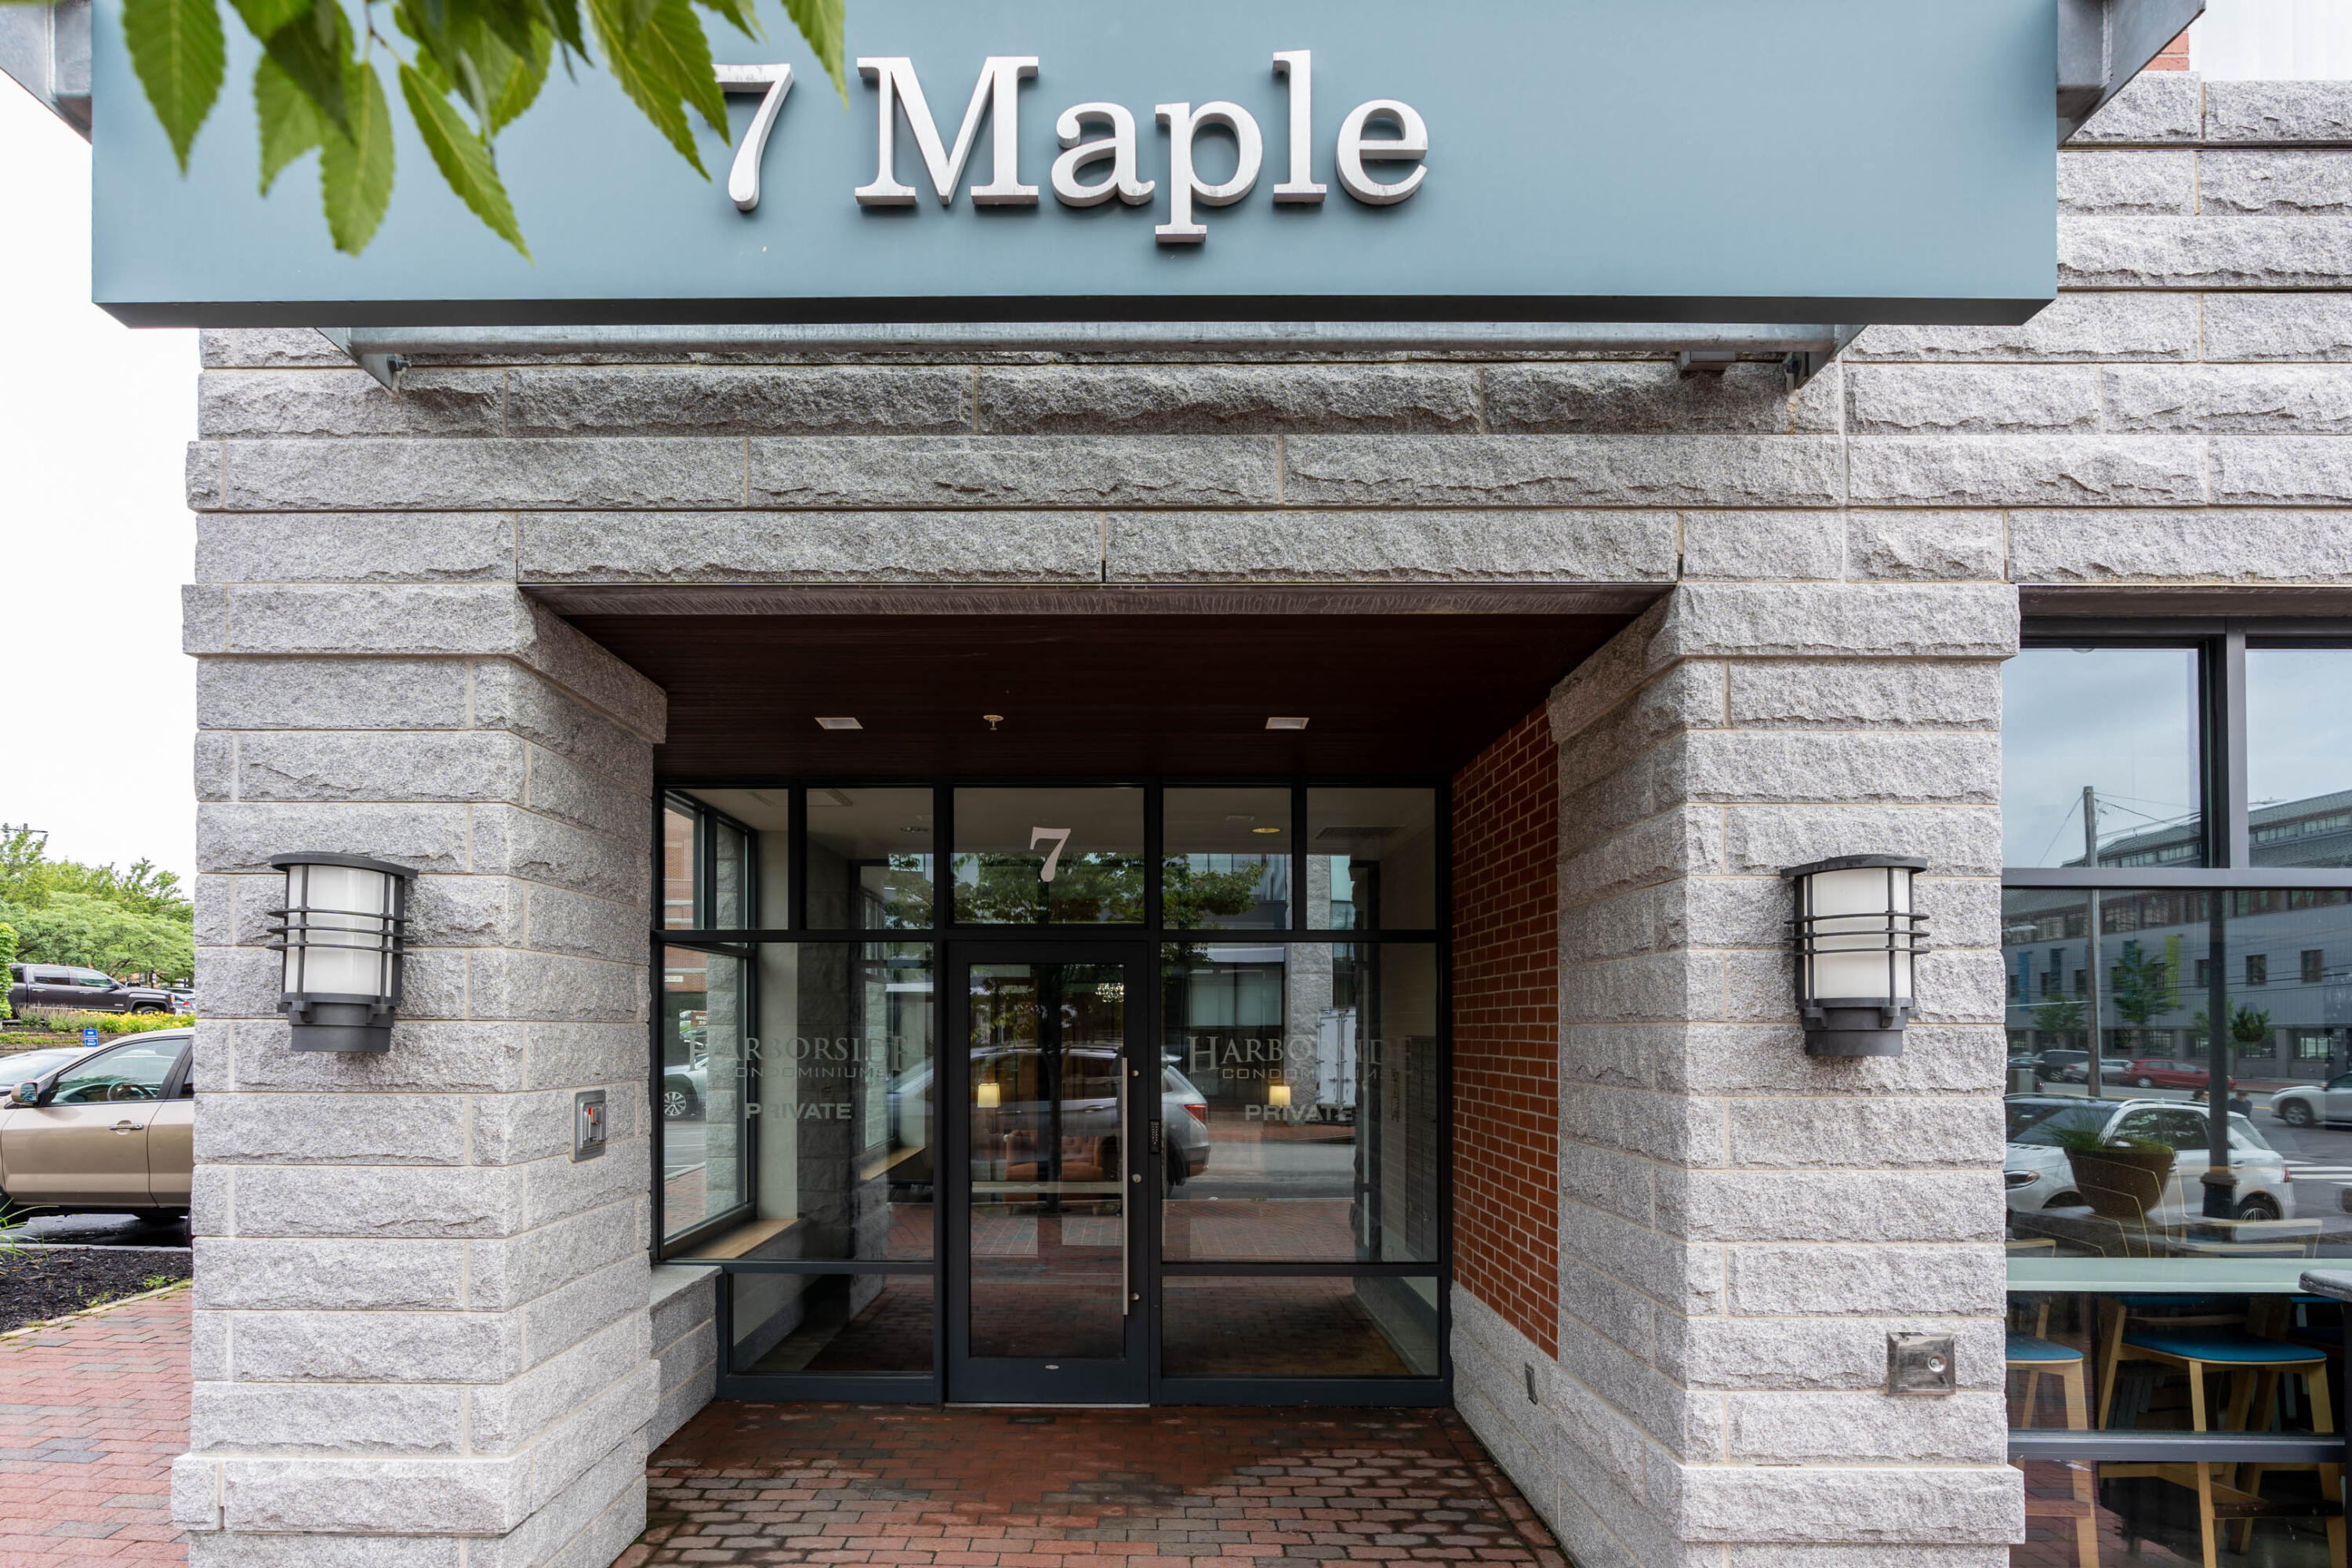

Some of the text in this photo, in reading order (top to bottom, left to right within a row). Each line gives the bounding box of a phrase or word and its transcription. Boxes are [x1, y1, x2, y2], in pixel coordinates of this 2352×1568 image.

[711, 49, 1428, 242] 7 Maple
[1029, 827, 1071, 882] 7
[688, 1035, 909, 1072] HRBORSIDE
[1187, 1036, 1412, 1074] HARBORIDE
[734, 1067, 891, 1078] ONDOMINIUMS
[1222, 1069, 1392, 1079] CONDOMMS
[746, 1102, 852, 1120] PRIVATE
[1245, 1104, 1354, 1121] PRIVATE
